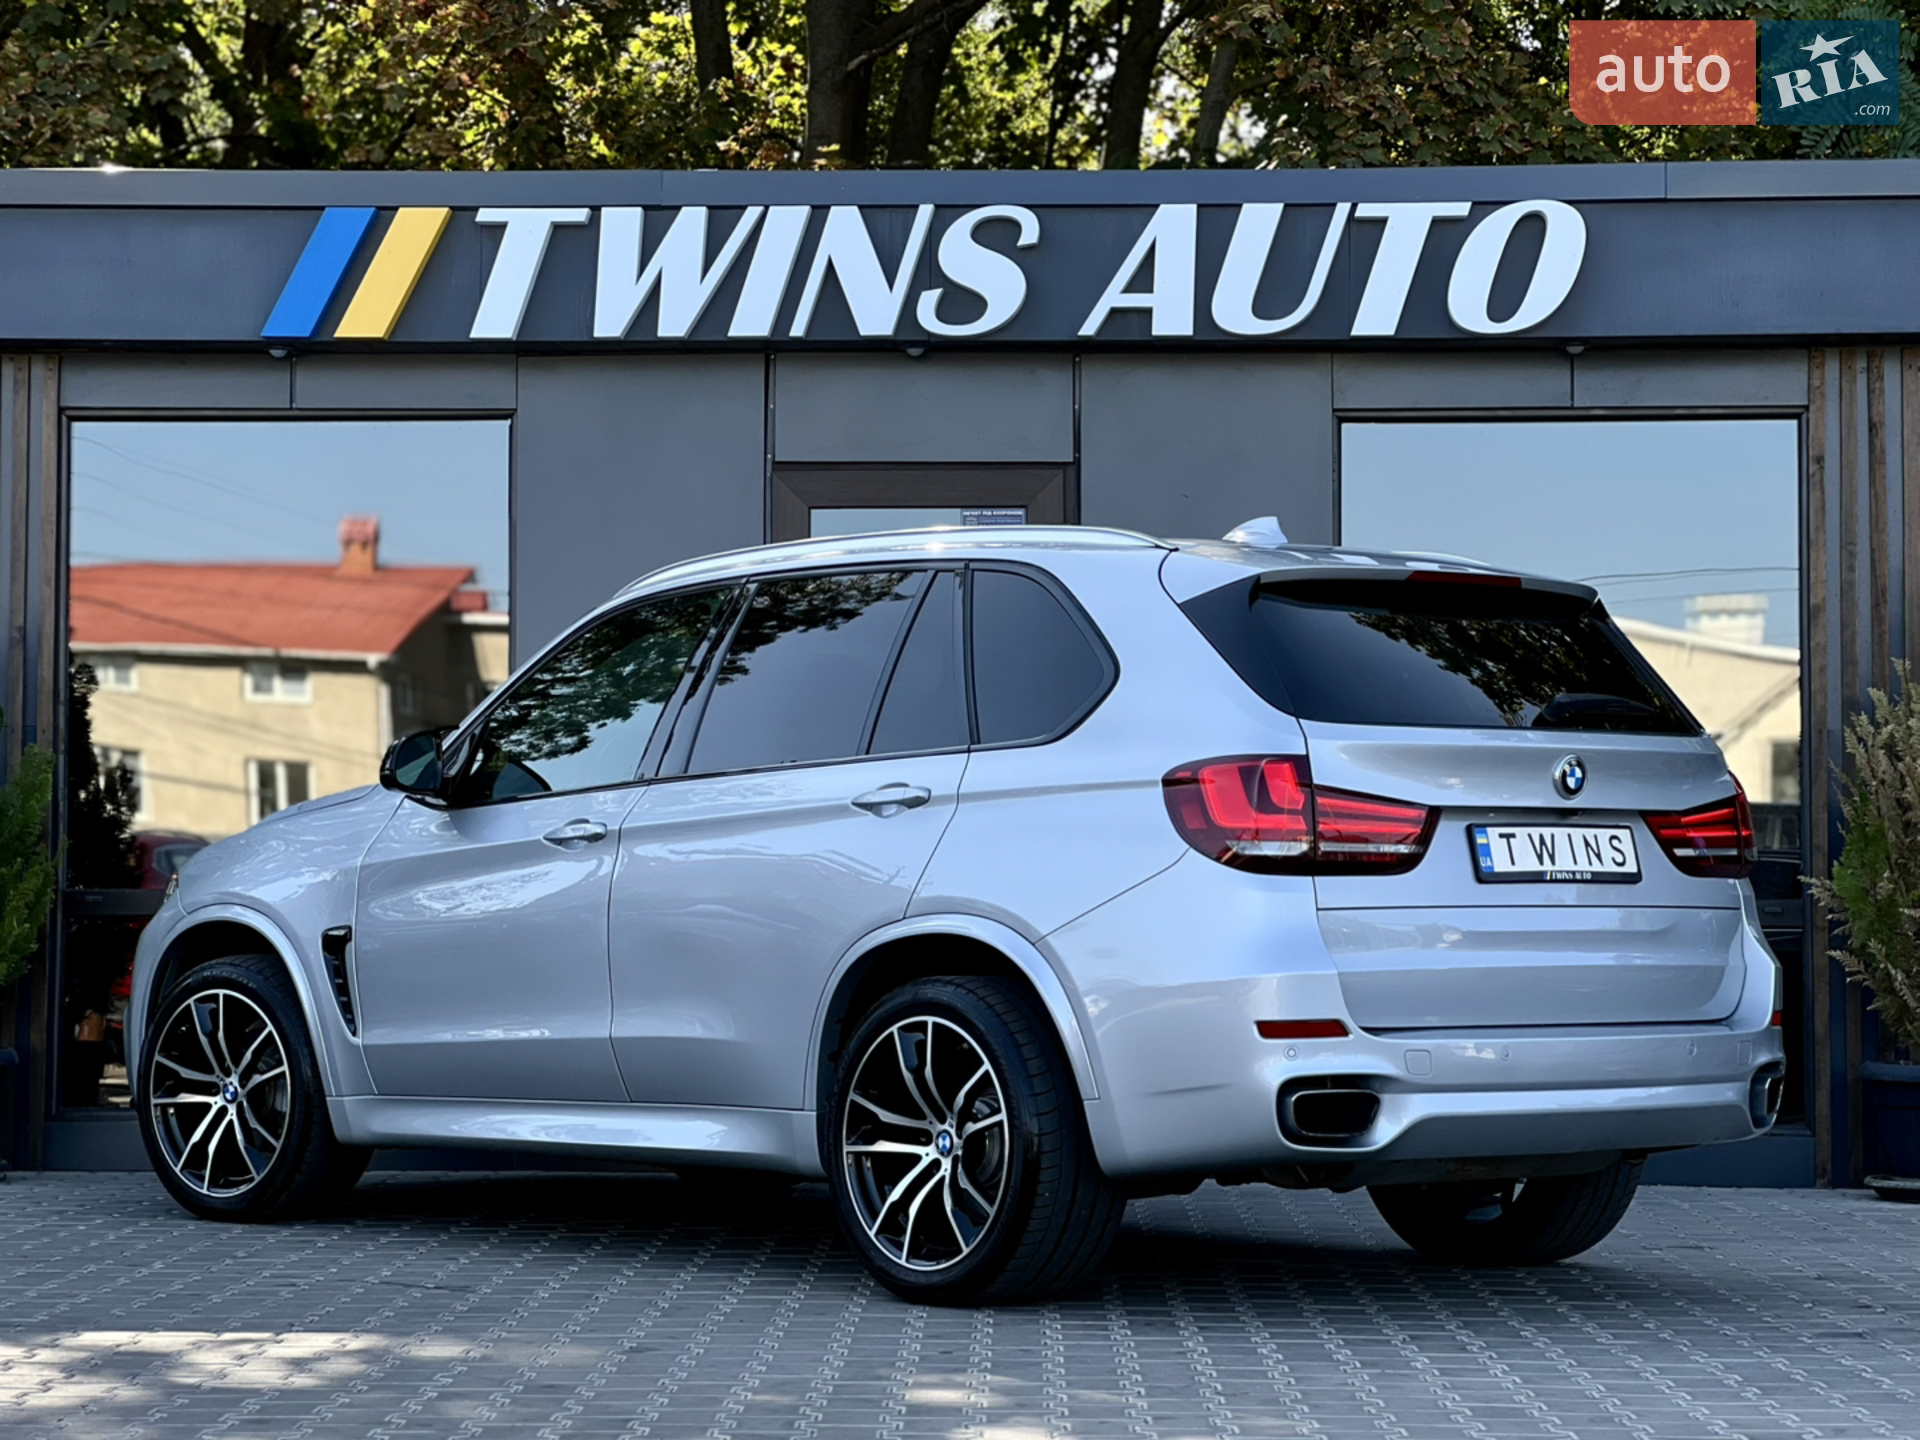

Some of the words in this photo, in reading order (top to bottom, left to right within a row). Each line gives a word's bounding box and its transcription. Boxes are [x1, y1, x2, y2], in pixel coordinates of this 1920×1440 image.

[470, 204, 1041, 339] TWINS
[1078, 199, 1588, 338] AUTO
[1480, 857, 1493, 868] UA
[1498, 832, 1627, 867] TWINS
